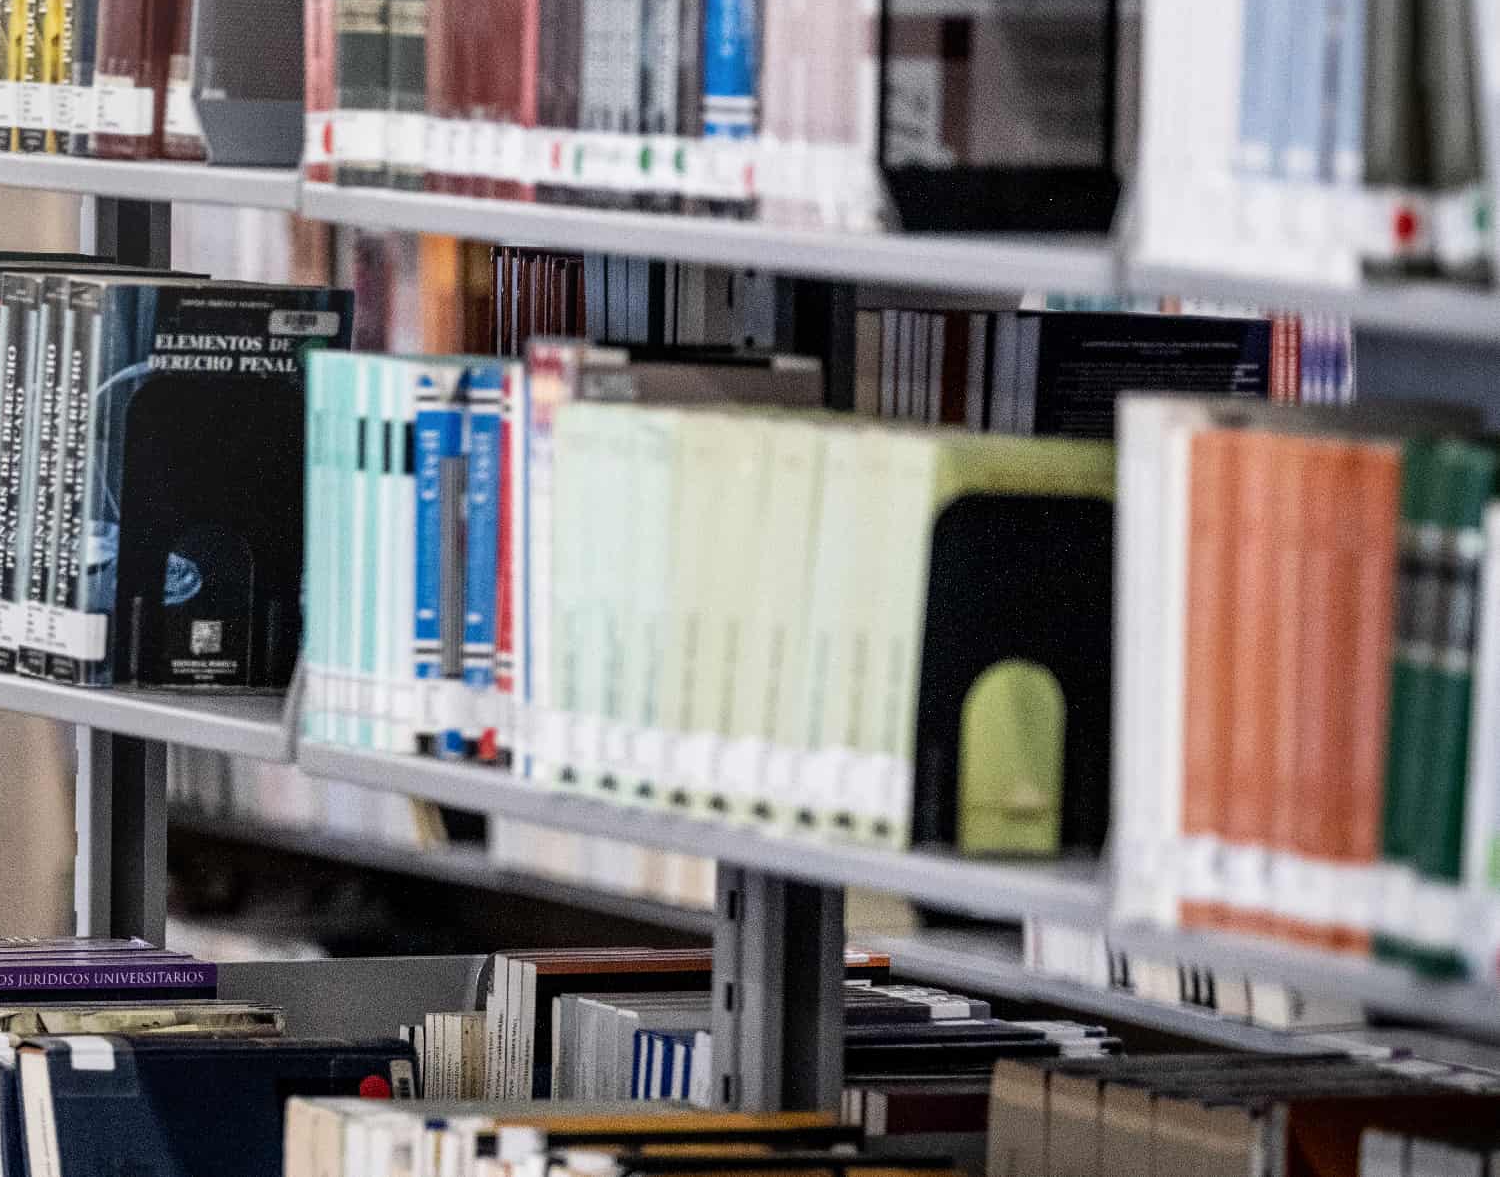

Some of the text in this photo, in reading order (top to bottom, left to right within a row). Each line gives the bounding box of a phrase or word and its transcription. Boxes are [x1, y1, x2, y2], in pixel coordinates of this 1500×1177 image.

[147, 355, 297, 373] DERECHO PENAL
[154, 333, 295, 352] ELEMENTOS DE
[1, 346, 17, 441] DERECHO
[41, 344, 57, 440] DERECHO
[67, 350, 83, 447] DERECHO
[0, 452, 12, 477] DE
[6, 387, 25, 568] PENAL MEXICANO
[37, 452, 49, 477] DE
[45, 386, 63, 567] PENAL MEXICANO
[64, 460, 76, 484] DE
[69, 393, 89, 576] PENAL MEXICANO
[94, 970, 205, 986] UNIVERSITARIOS
